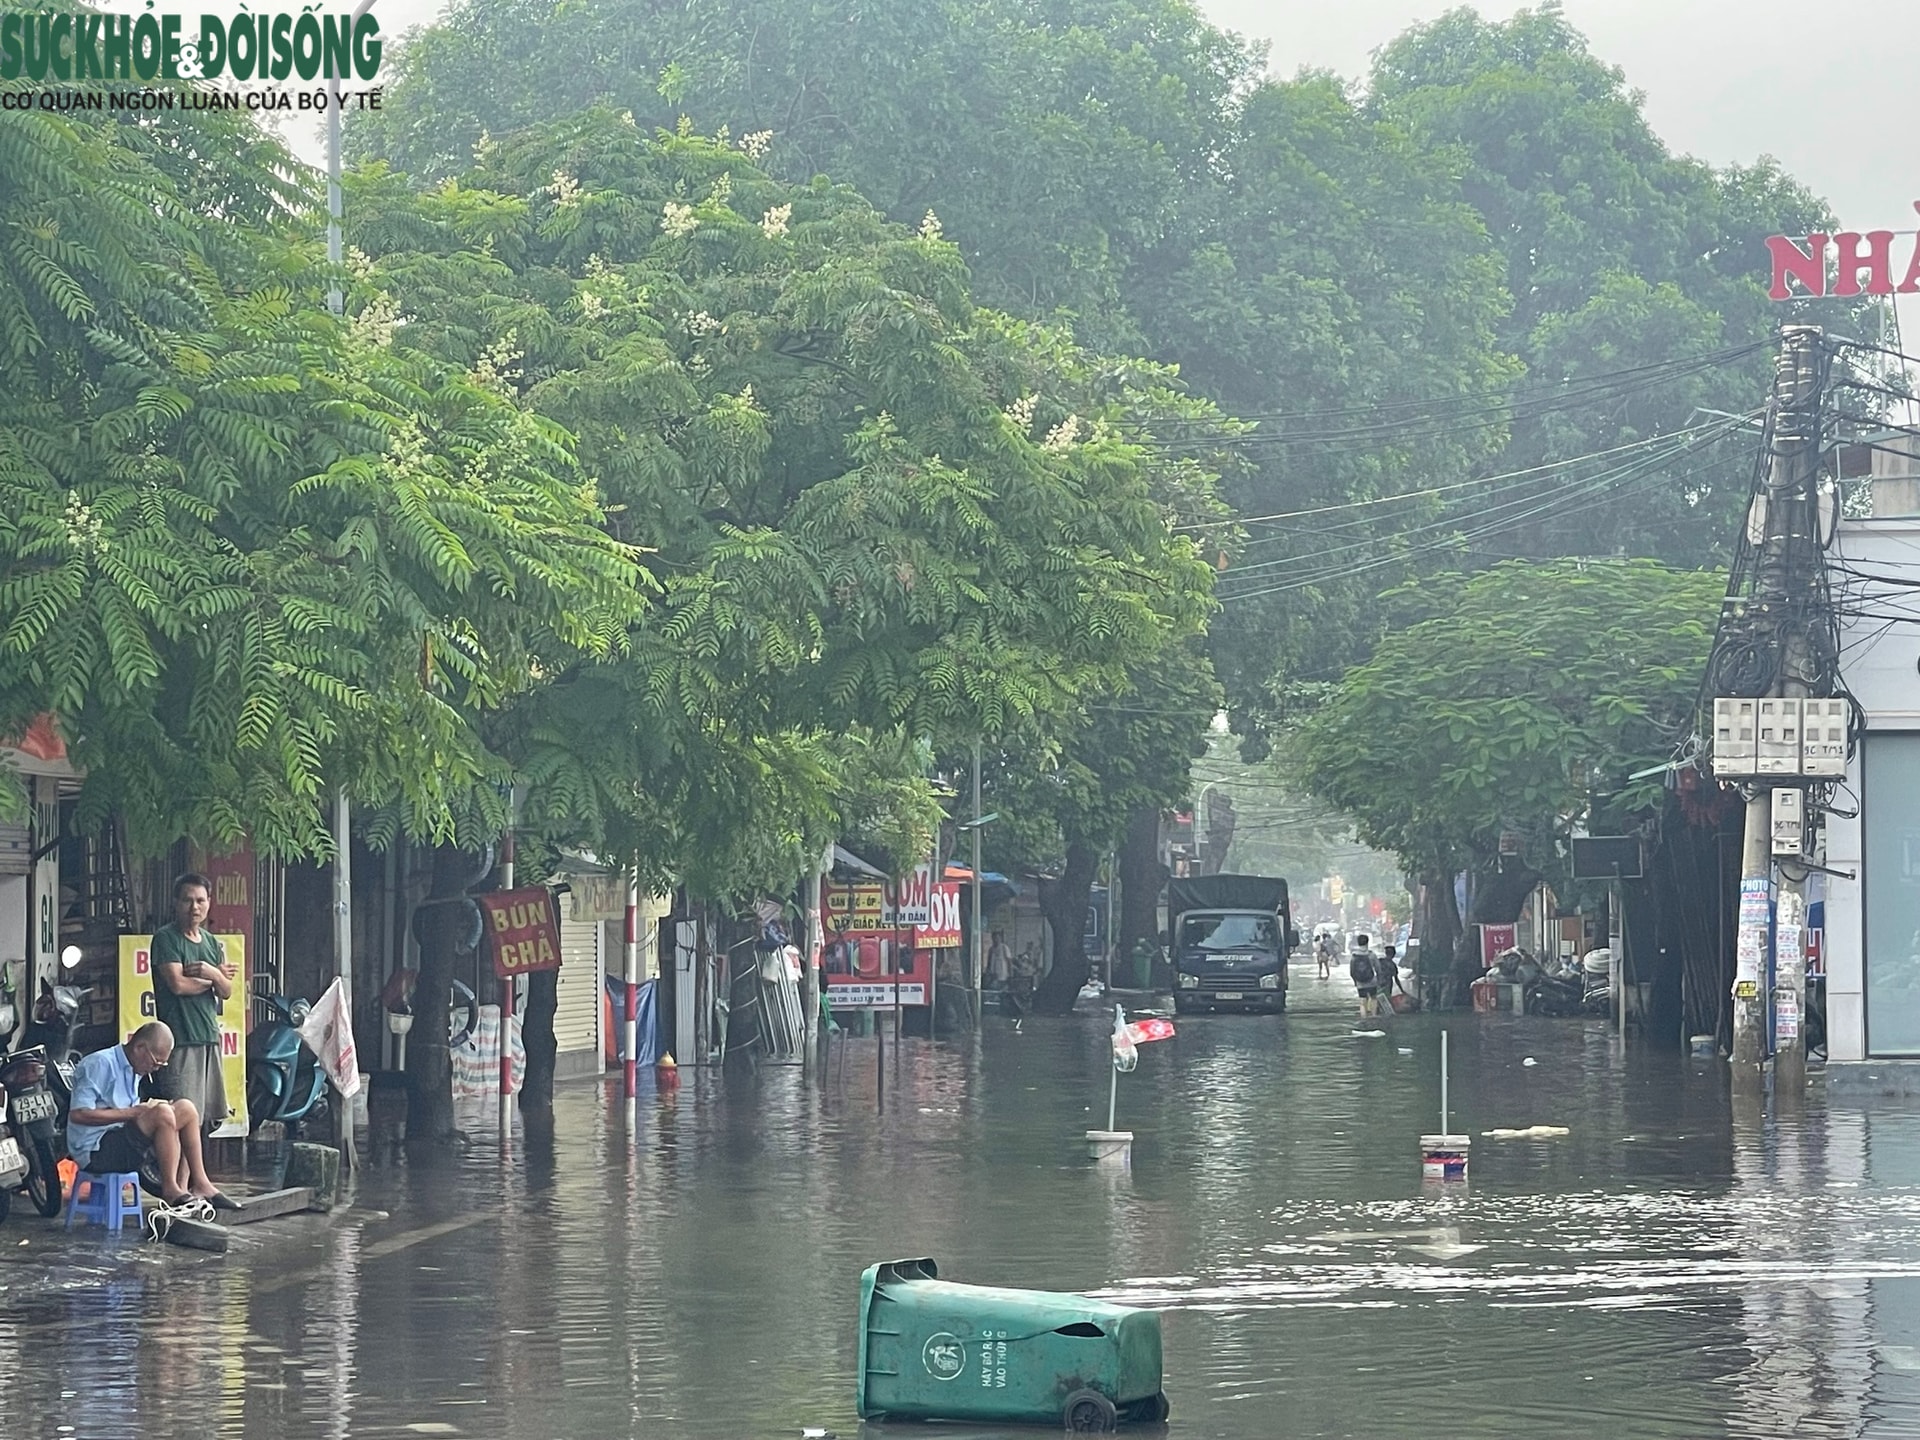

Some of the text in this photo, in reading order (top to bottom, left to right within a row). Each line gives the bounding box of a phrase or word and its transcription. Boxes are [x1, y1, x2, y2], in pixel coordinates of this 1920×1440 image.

[1740, 879, 1769, 892] PHOTO
[491, 901, 547, 933] BÚN
[916, 885, 961, 932] ƠM
[501, 930, 555, 969] CHẢ
[994, 1367, 1007, 1388] VÀO
